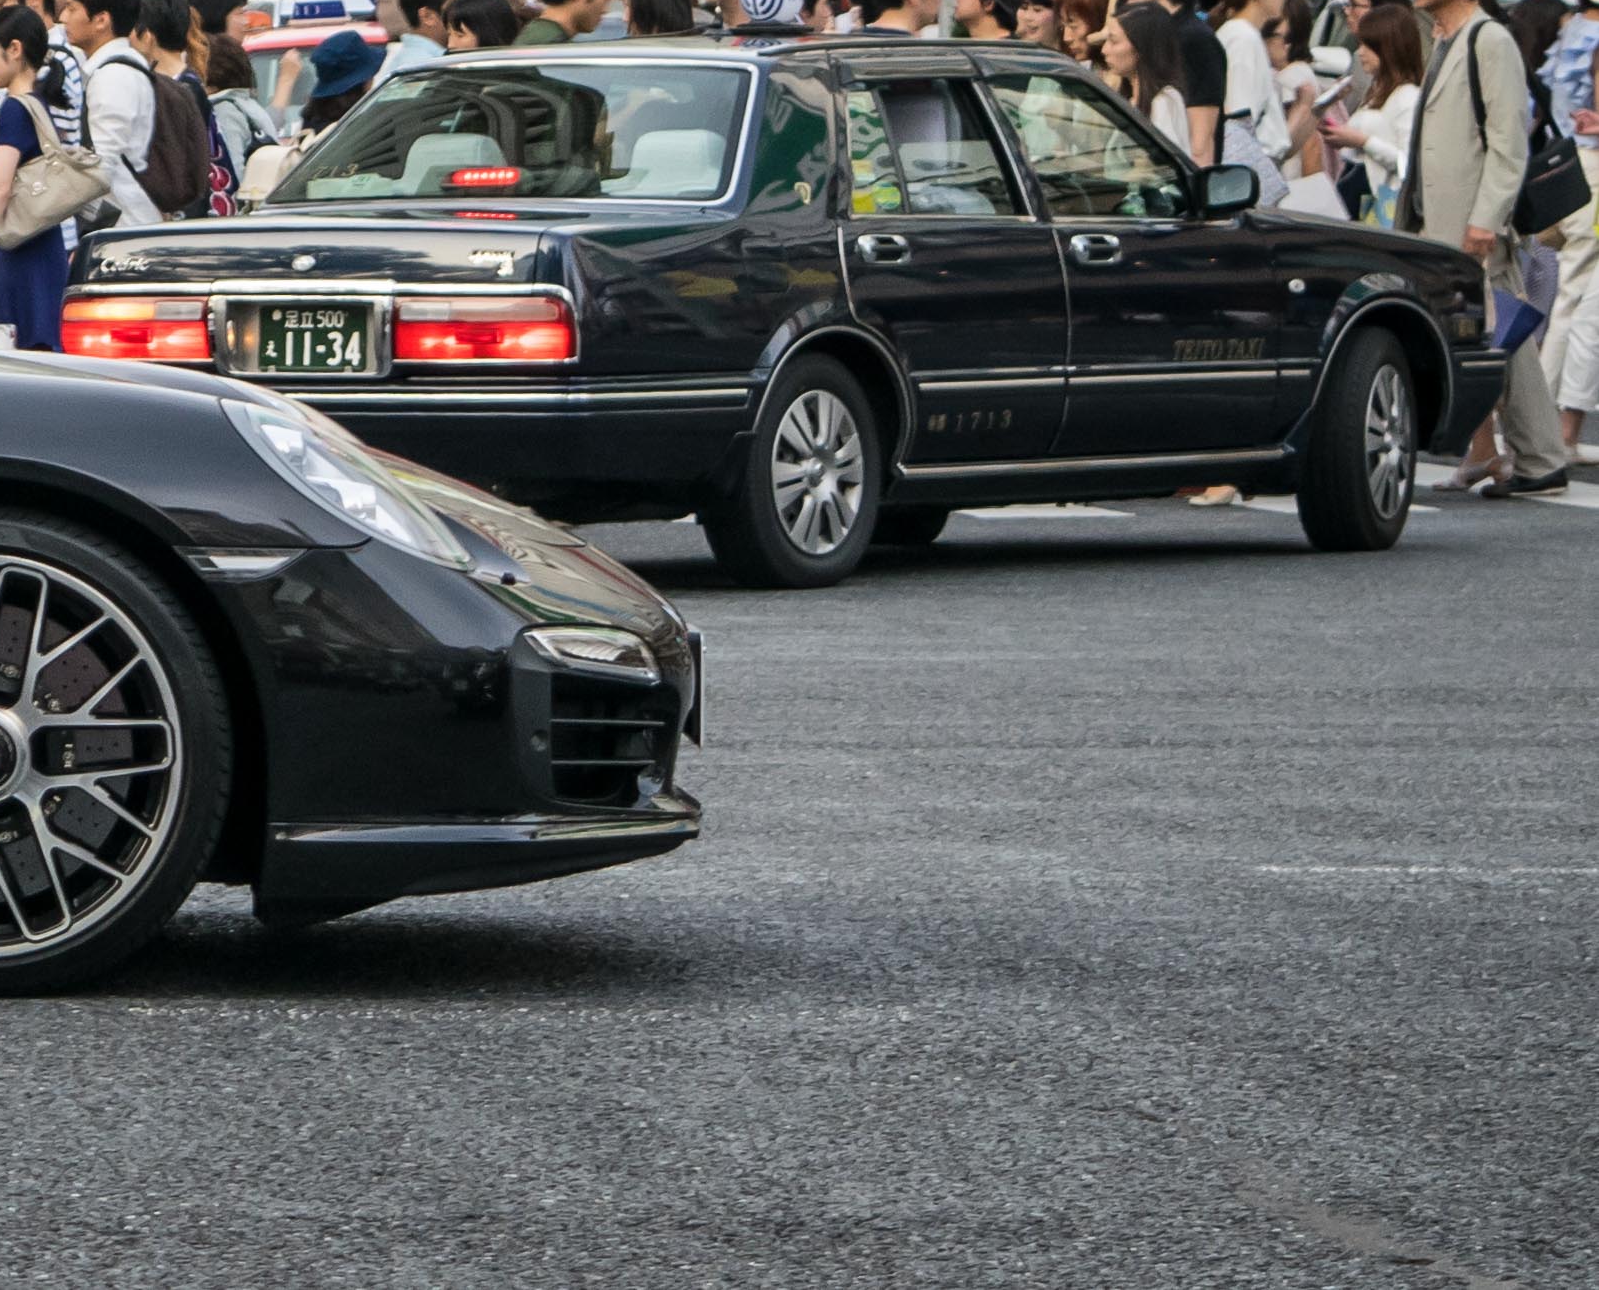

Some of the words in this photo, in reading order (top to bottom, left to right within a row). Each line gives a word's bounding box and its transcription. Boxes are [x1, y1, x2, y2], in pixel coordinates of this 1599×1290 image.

[284, 310, 314, 328] 足立
[317, 310, 344, 328] 500
[285, 330, 362, 366] 11-34
[1227, 337, 1265, 359] TAXI
